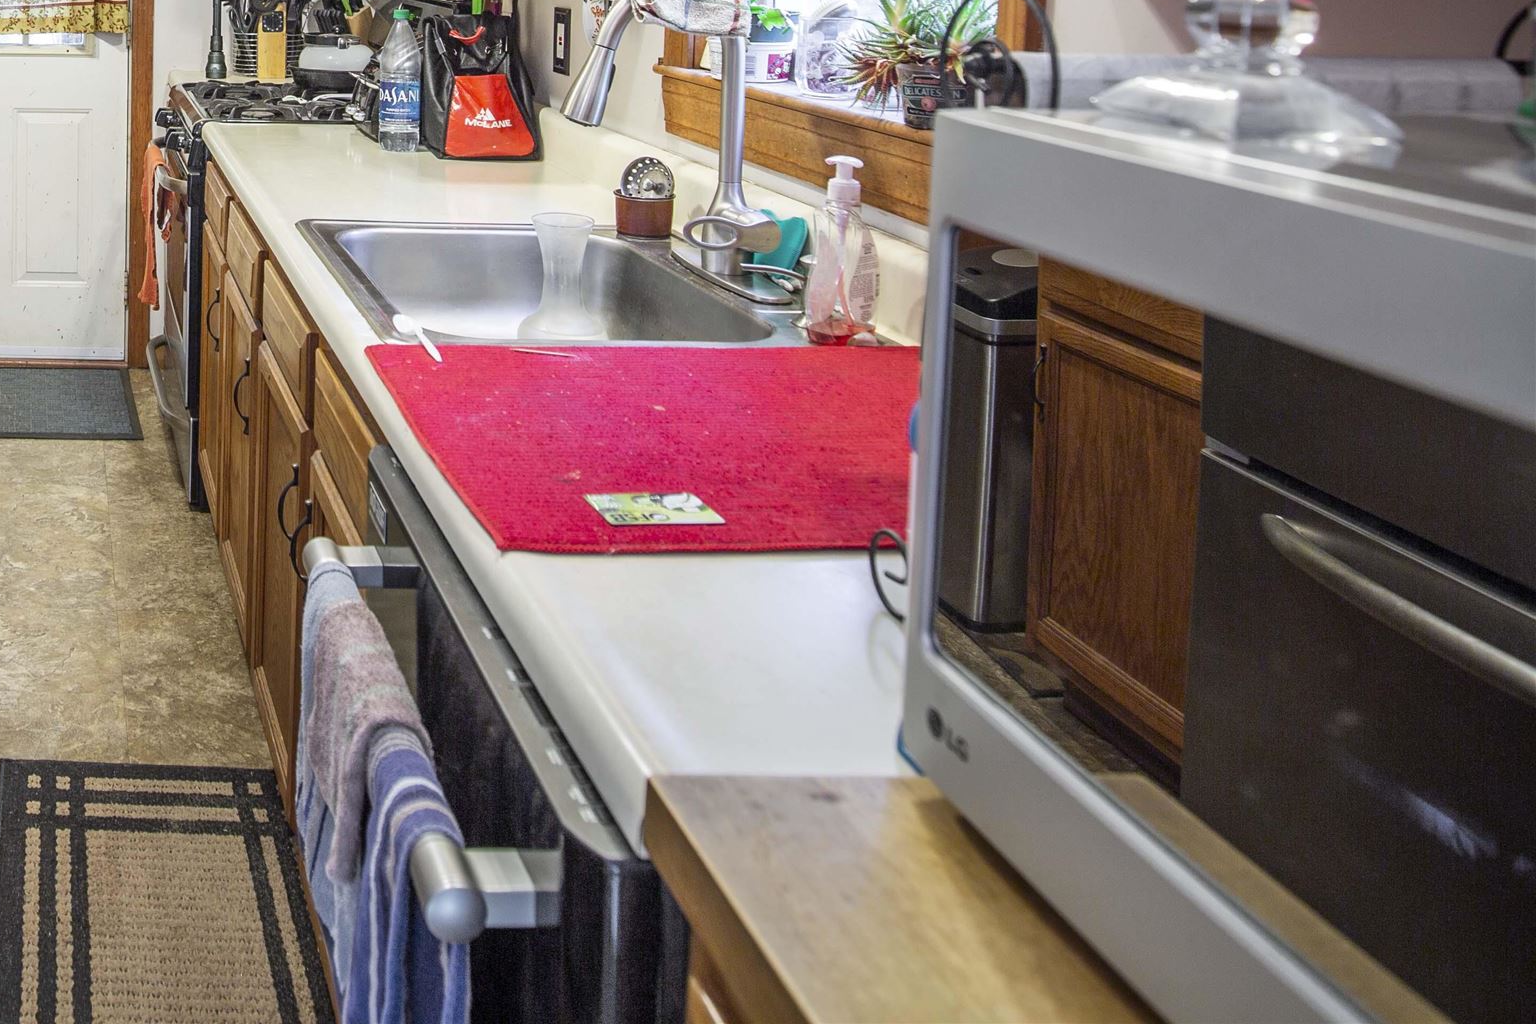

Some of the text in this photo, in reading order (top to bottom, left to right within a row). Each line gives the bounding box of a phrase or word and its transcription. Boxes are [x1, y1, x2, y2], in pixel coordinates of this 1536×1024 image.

[379, 86, 420, 106] DASANI
[904, 86, 961, 99] DELICATESN
[944, 726, 970, 764] LG
